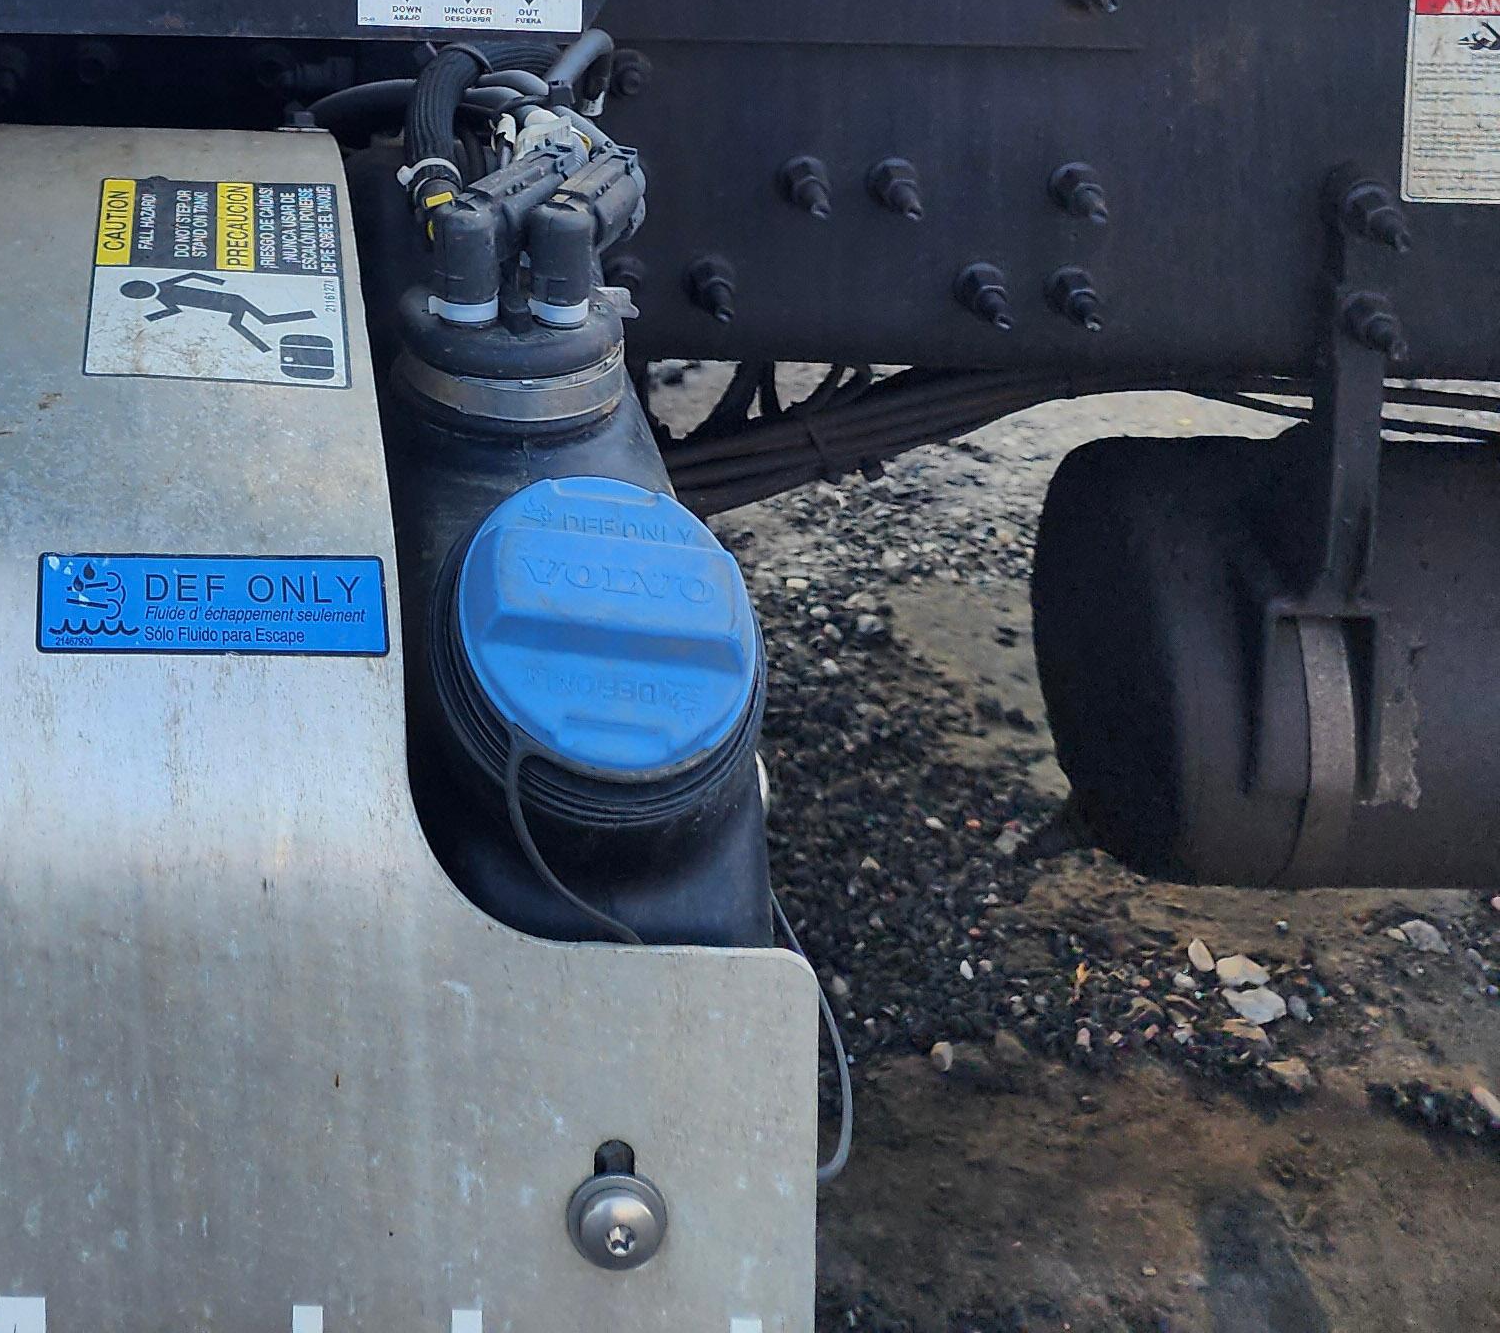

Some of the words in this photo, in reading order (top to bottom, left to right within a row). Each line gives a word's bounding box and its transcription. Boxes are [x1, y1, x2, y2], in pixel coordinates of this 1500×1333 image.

[392, 5, 423, 14] DOWN
[443, 7, 493, 15] UNCOVER
[518, 8, 540, 17] OUT
[515, 17, 542, 25] FUERA
[176, 189, 192, 202] OR
[280, 192, 296, 204] DE
[298, 187, 315, 222] PONERSE
[139, 192, 157, 227] HAZARD!
[174, 203, 191, 224] STEP
[281, 204, 297, 228] USAR
[318, 213, 334, 223] EL
[103, 190, 129, 251] CAUTION
[193, 213, 209, 228] ON
[221, 185, 249, 267] PRECAUCIÓN
[258, 219, 274, 231] DE
[300, 221, 316, 231] NI
[137, 226, 155, 251] FALL
[173, 223, 191, 244] NOT
[191, 228, 208, 258] STAND
[319, 222, 336, 249] SOBRE
[174, 244, 190, 258] DO
[299, 231, 318, 270] ESCALÓN
[320, 249, 337, 262] PIE
[322, 262, 338, 274] DE
[563, 512, 616, 536] DEF
[144, 573, 227, 603] DEF
[247, 574, 362, 605] ONLY
[520, 556, 715, 605] VOLVO
[145, 605, 186, 622] Fluide
[204, 606, 294, 626] échappement
[295, 609, 367, 624] seulement
[144, 625, 174, 642] Sólo
[177, 626, 219, 643] Fluido
[222, 630, 251, 646] para
[255, 628, 305, 648] Escape
